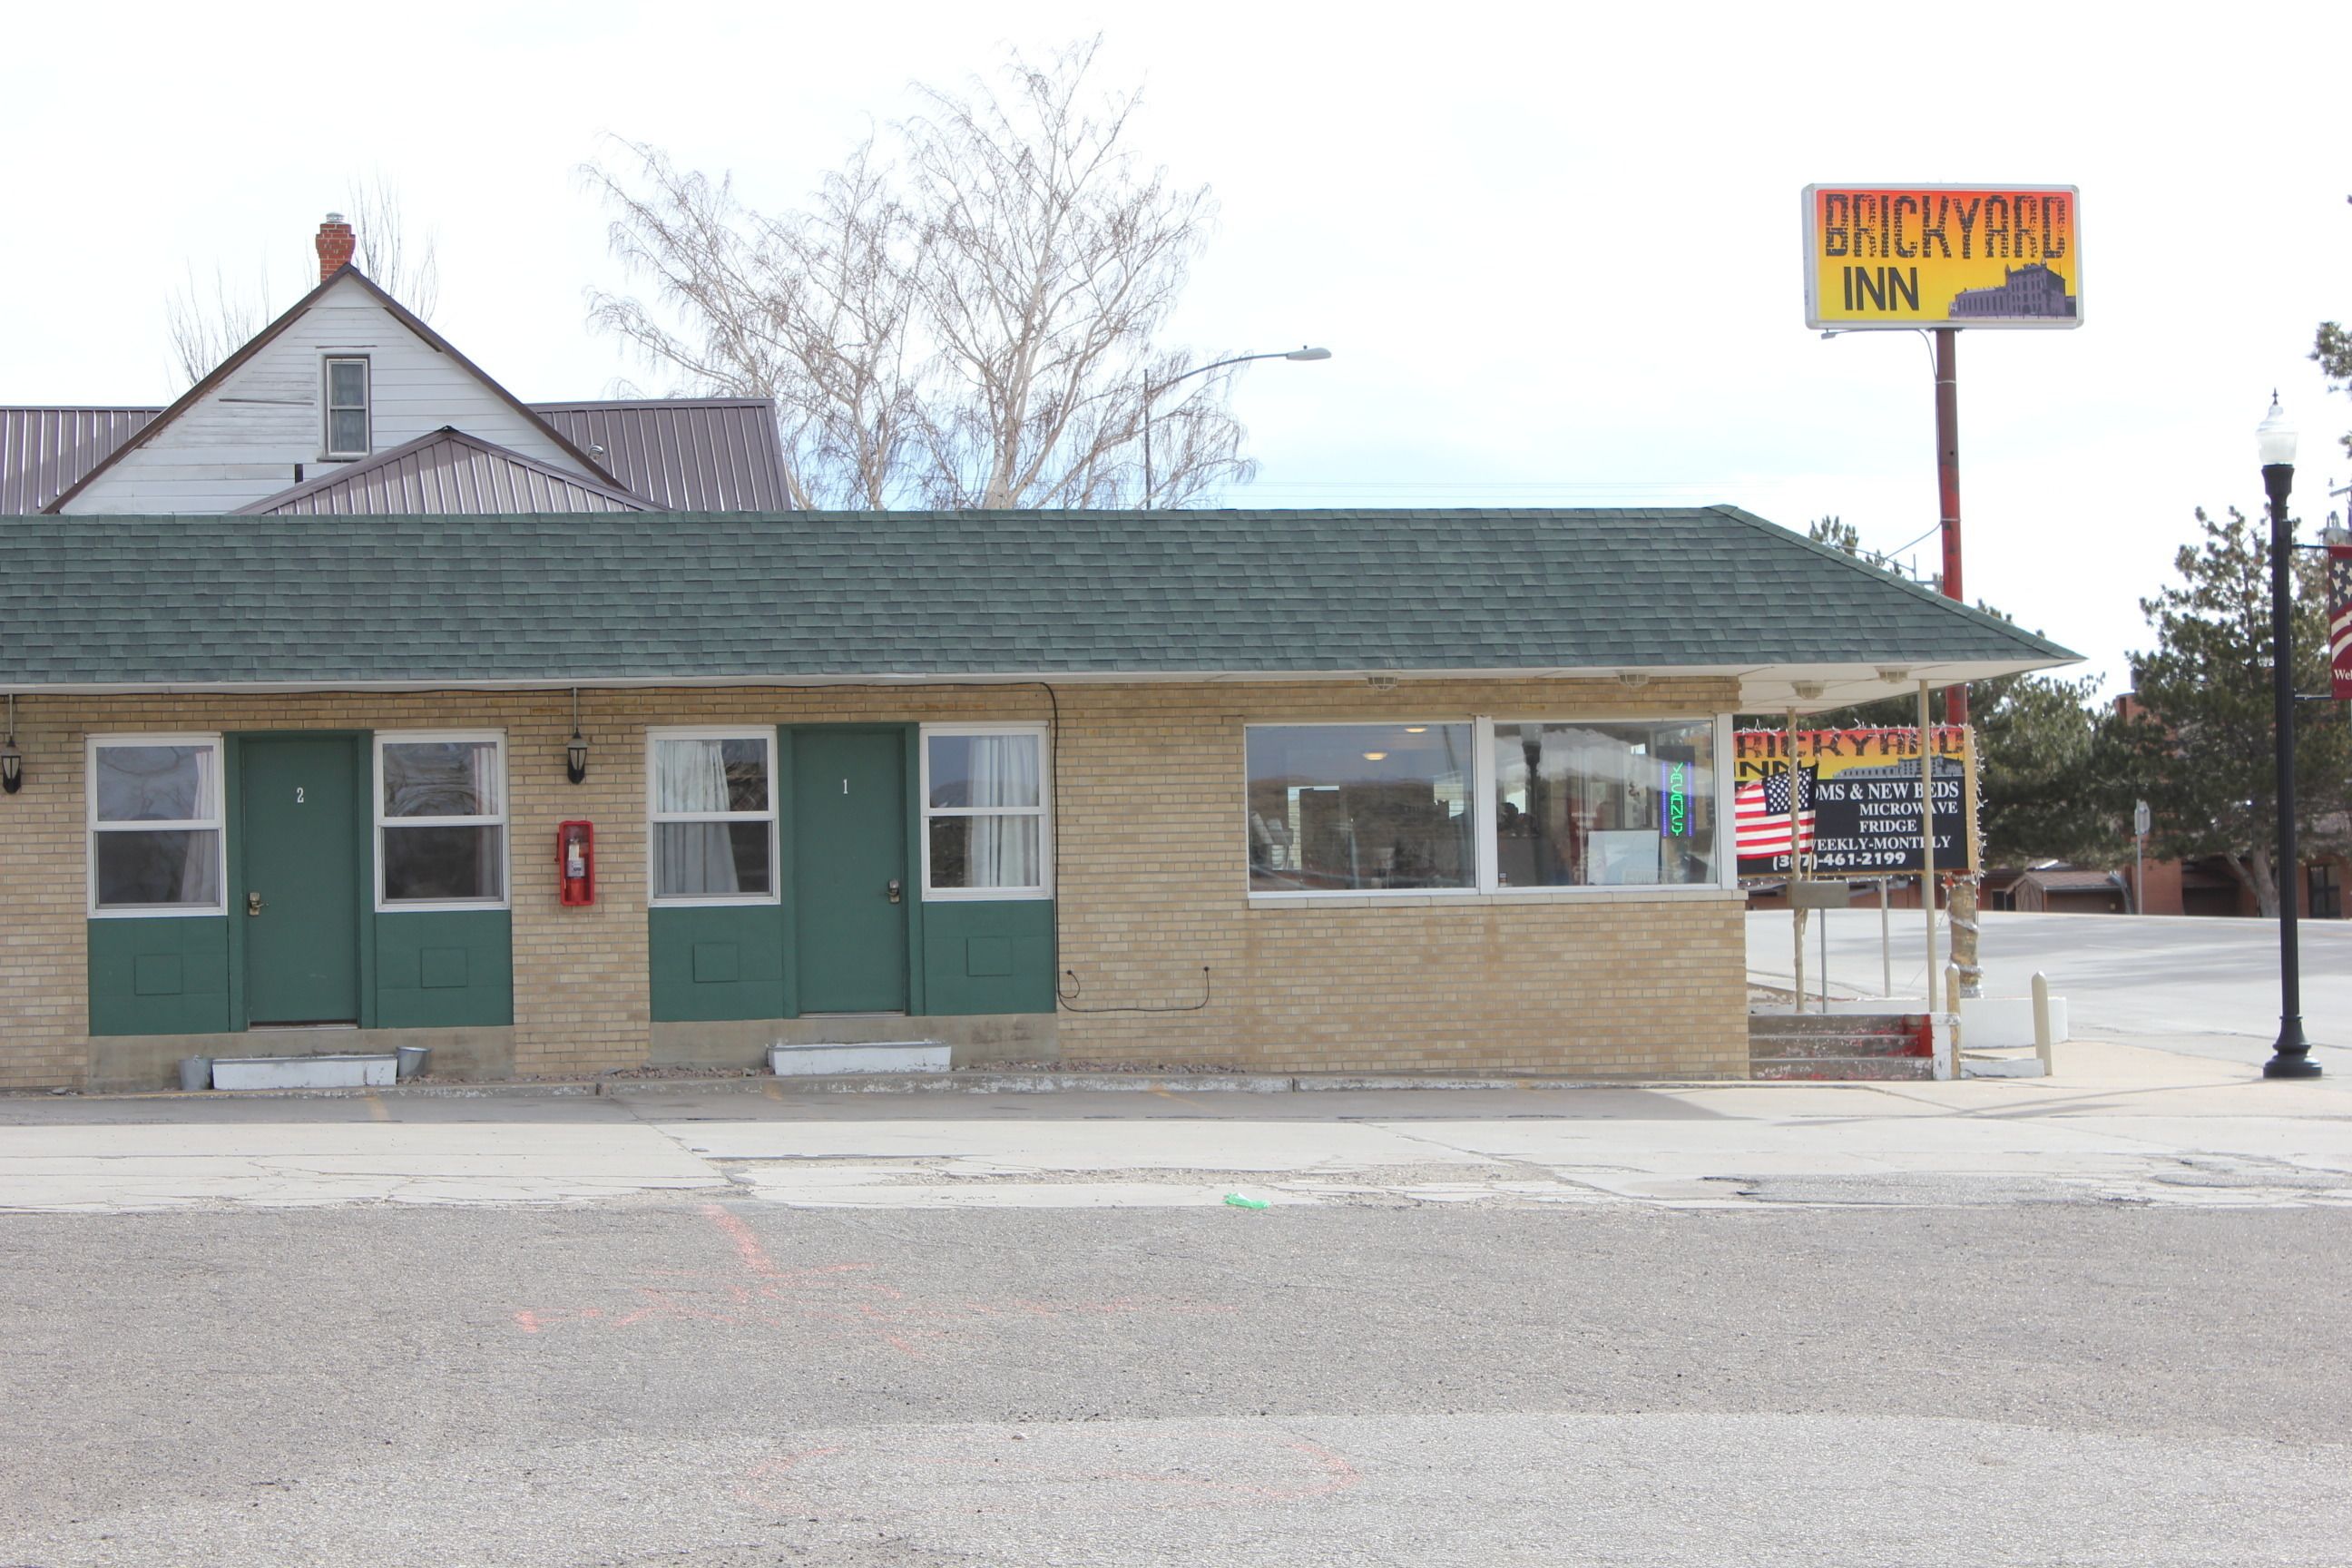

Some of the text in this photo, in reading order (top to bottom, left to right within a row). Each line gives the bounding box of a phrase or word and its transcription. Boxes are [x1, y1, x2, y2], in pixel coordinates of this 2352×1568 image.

[1825, 192, 2066, 260] BRICKYARD
[1843, 266, 1920, 311] INN
[297, 787, 305, 803] 2
[843, 779, 848, 795] 1
[1815, 780, 1960, 800] MS & NEW BEDS
[1670, 761, 1684, 837] VACANCY
[1859, 818, 1918, 833] FRIDGE
[1813, 835, 1952, 851] EEKLY-MONTLY
[1772, 852, 1907, 871] (37)-461-2199
